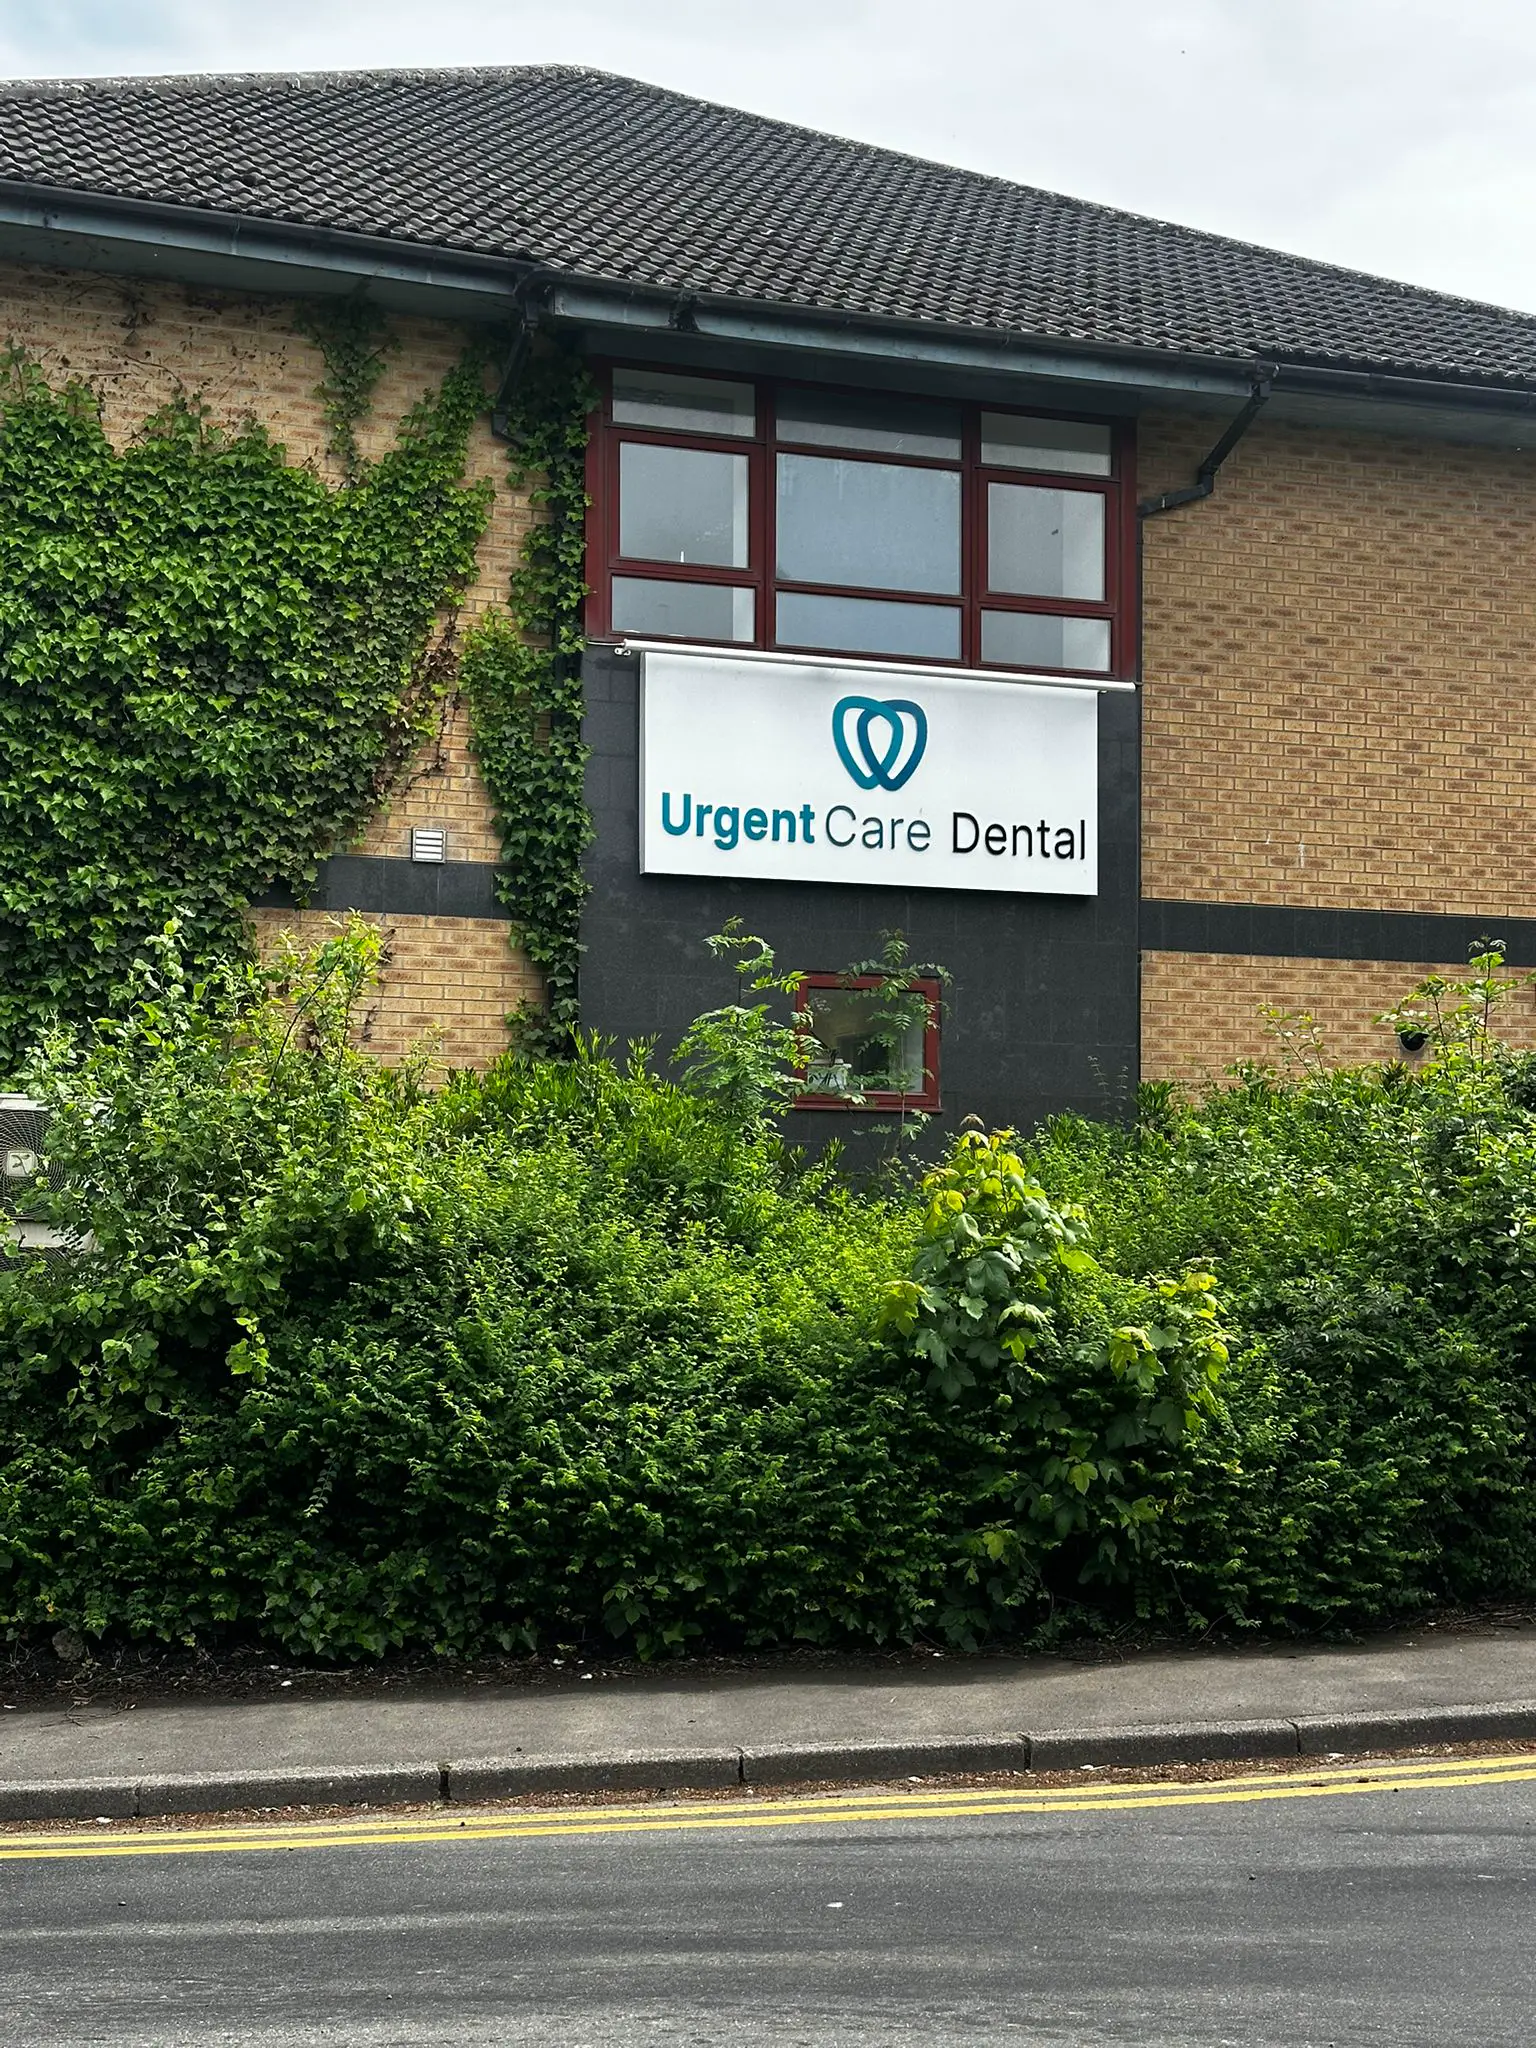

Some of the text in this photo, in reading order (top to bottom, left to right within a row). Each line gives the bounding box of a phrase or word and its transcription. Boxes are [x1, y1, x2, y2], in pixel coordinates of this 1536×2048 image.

[661, 791, 1086, 860] Urgent Care Dental
